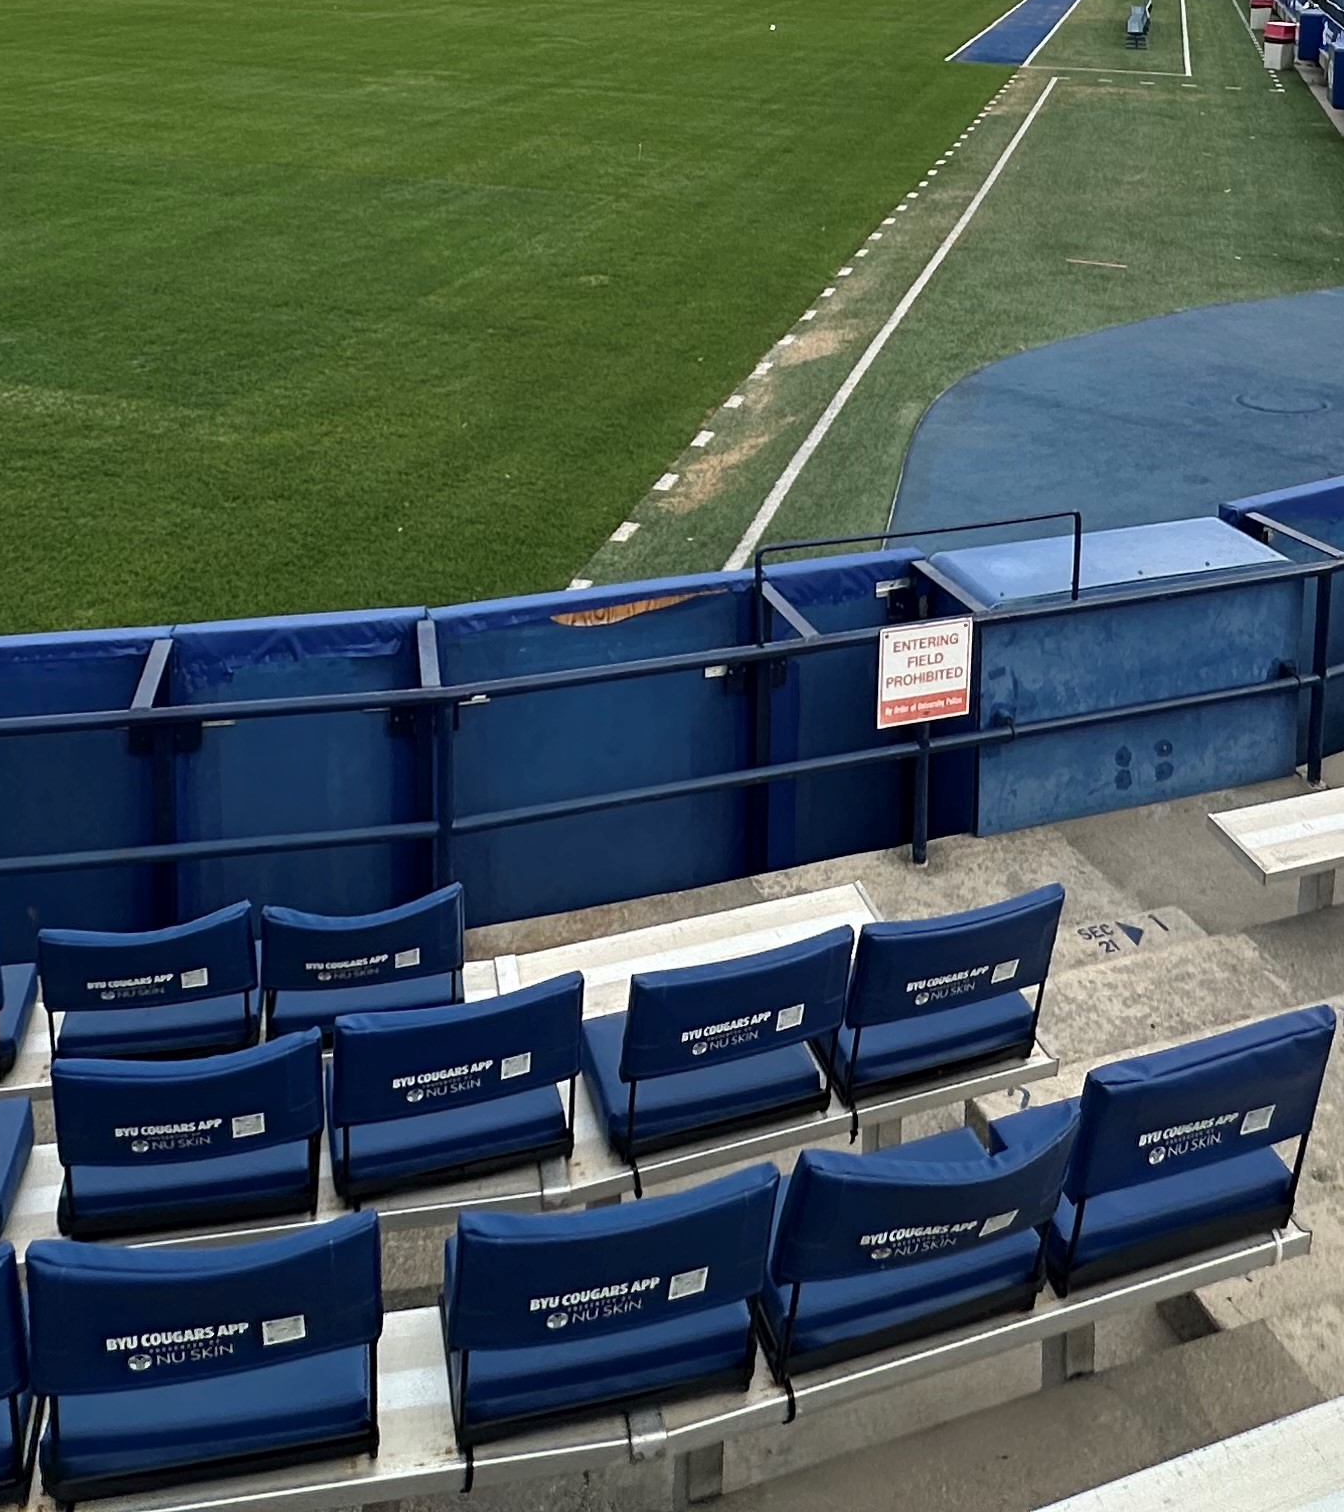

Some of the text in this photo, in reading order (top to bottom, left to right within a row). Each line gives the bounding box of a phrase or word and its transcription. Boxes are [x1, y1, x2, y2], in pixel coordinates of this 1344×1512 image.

[892, 633, 959, 653] ENTERING
[907, 652, 944, 669] FIELD
[885, 666, 964, 689] PROHIBITED
[885, 705, 893, 717] By
[1077, 923, 1114, 940] SEC
[1098, 939, 1121, 953] 21
[369, 954, 389, 965] APP
[154, 973, 174, 983] APP
[906, 965, 989, 993] BYU COUGARS APP
[929, 981, 975, 1001] NU SKIN
[681, 1011, 772, 1043] BYU COUGARS APP
[709, 1030, 759, 1051] NU SKIN
[392, 1059, 494, 1089] BYU COUGARS APP
[425, 1078, 481, 1099] NU SKIN
[114, 1118, 222, 1137] BYU COUGARS APP
[1138, 1130, 1163, 1147] BYU
[1162, 1117, 1215, 1139] COUGARS
[1215, 1112, 1239, 1127] APP
[151, 1135, 212, 1151] NU SKIN
[1167, 1141, 1189, 1158] NU
[1190, 1131, 1222, 1151] SKIN
[859, 1232, 888, 1245] BYU
[888, 1224, 950, 1242] COUGARS
[950, 1220, 978, 1233] APP
[894, 1243, 919, 1256] NU
[920, 1237, 956, 1251] SKIN
[529, 1296, 560, 1311] BYU
[561, 1282, 629, 1306] COUGARS
[630, 1276, 661, 1293] APP
[572, 1307, 599, 1324] NU
[603, 1298, 642, 1317] SKIN
[106, 1335, 138, 1351] BYU
[140, 1326, 215, 1347] COUGARS
[217, 1322, 249, 1337] APP
[156, 1351, 186, 1366] NU
[190, 1343, 234, 1361] SKIN
